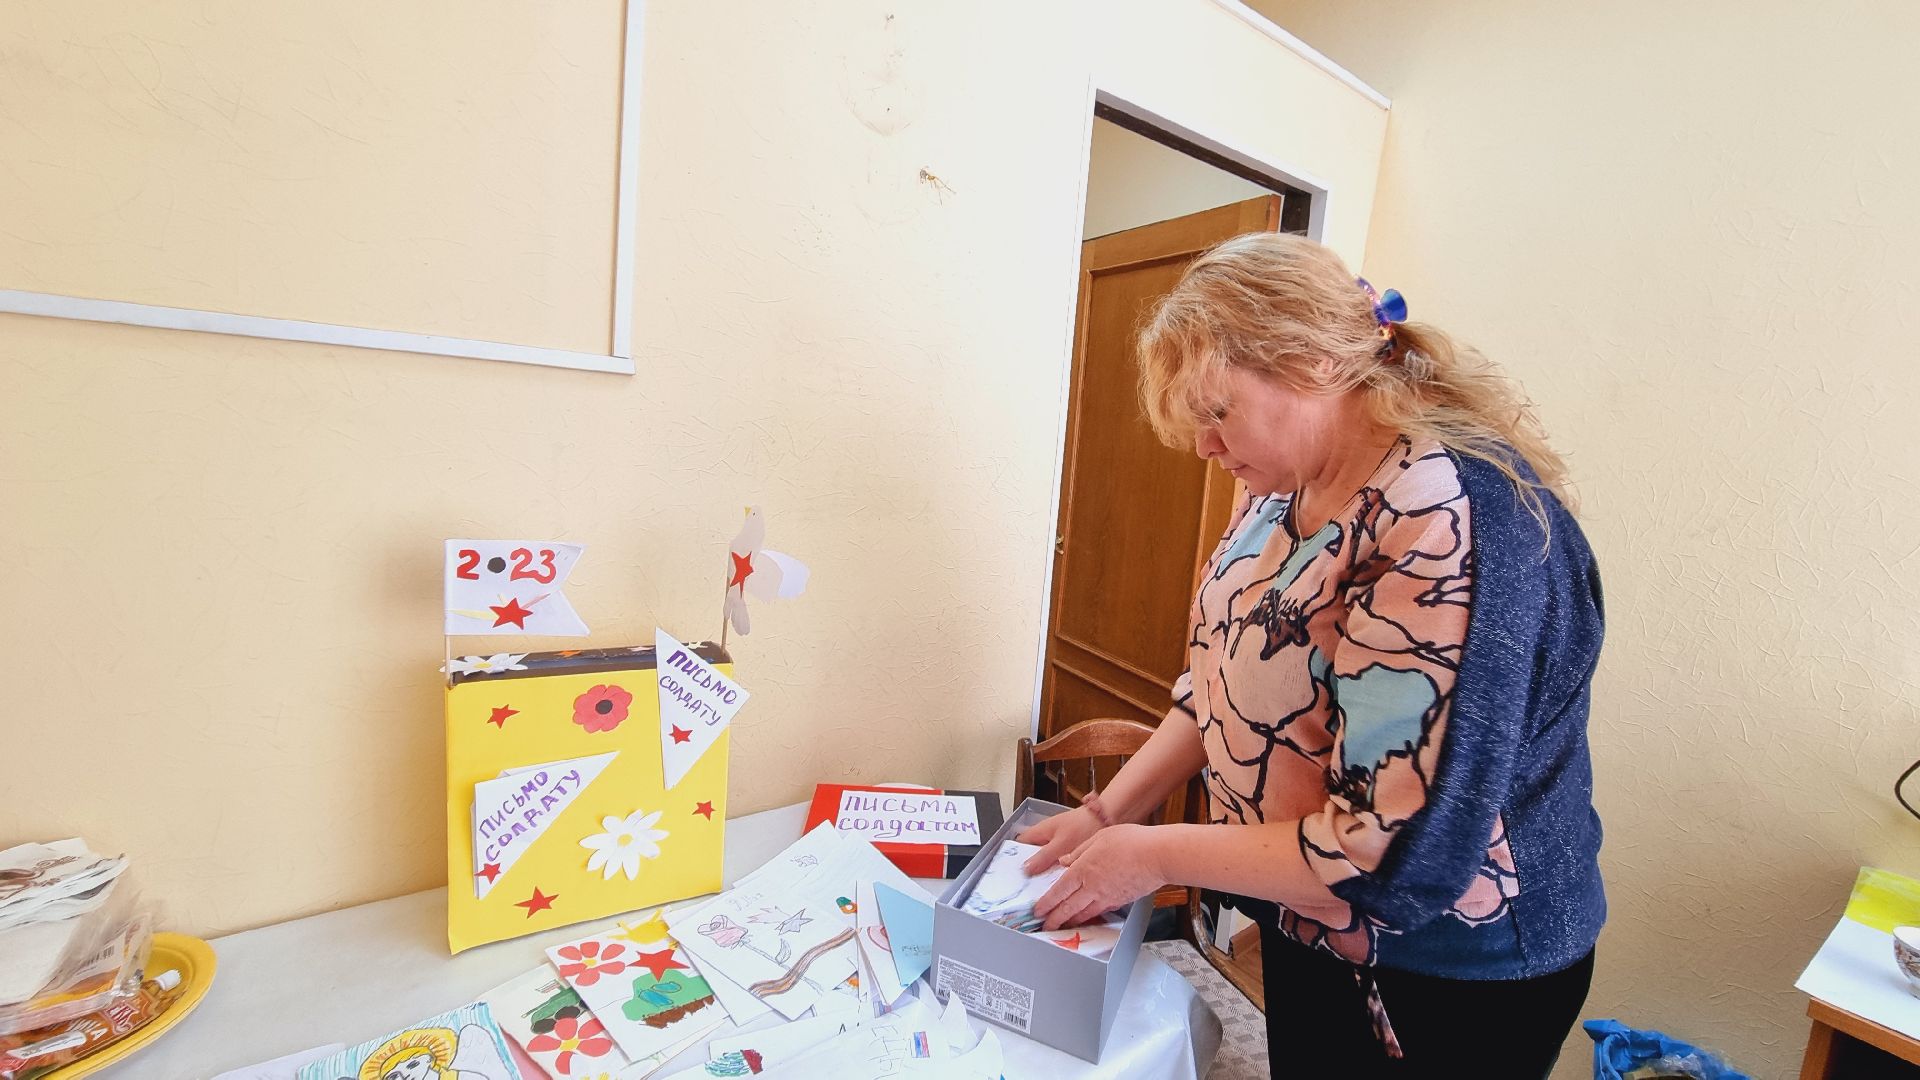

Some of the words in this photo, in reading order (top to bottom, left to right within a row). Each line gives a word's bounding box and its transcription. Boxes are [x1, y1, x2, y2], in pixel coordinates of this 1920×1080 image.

[659, 675, 722, 727] СОЛДАТУ
[666, 650, 738, 705] ПИСЬМО
[479, 771, 549, 839] ПИСЬМО
[485, 769, 581, 862] СОЛДАТУ
[844, 795, 958, 815] ПИСЬМА
